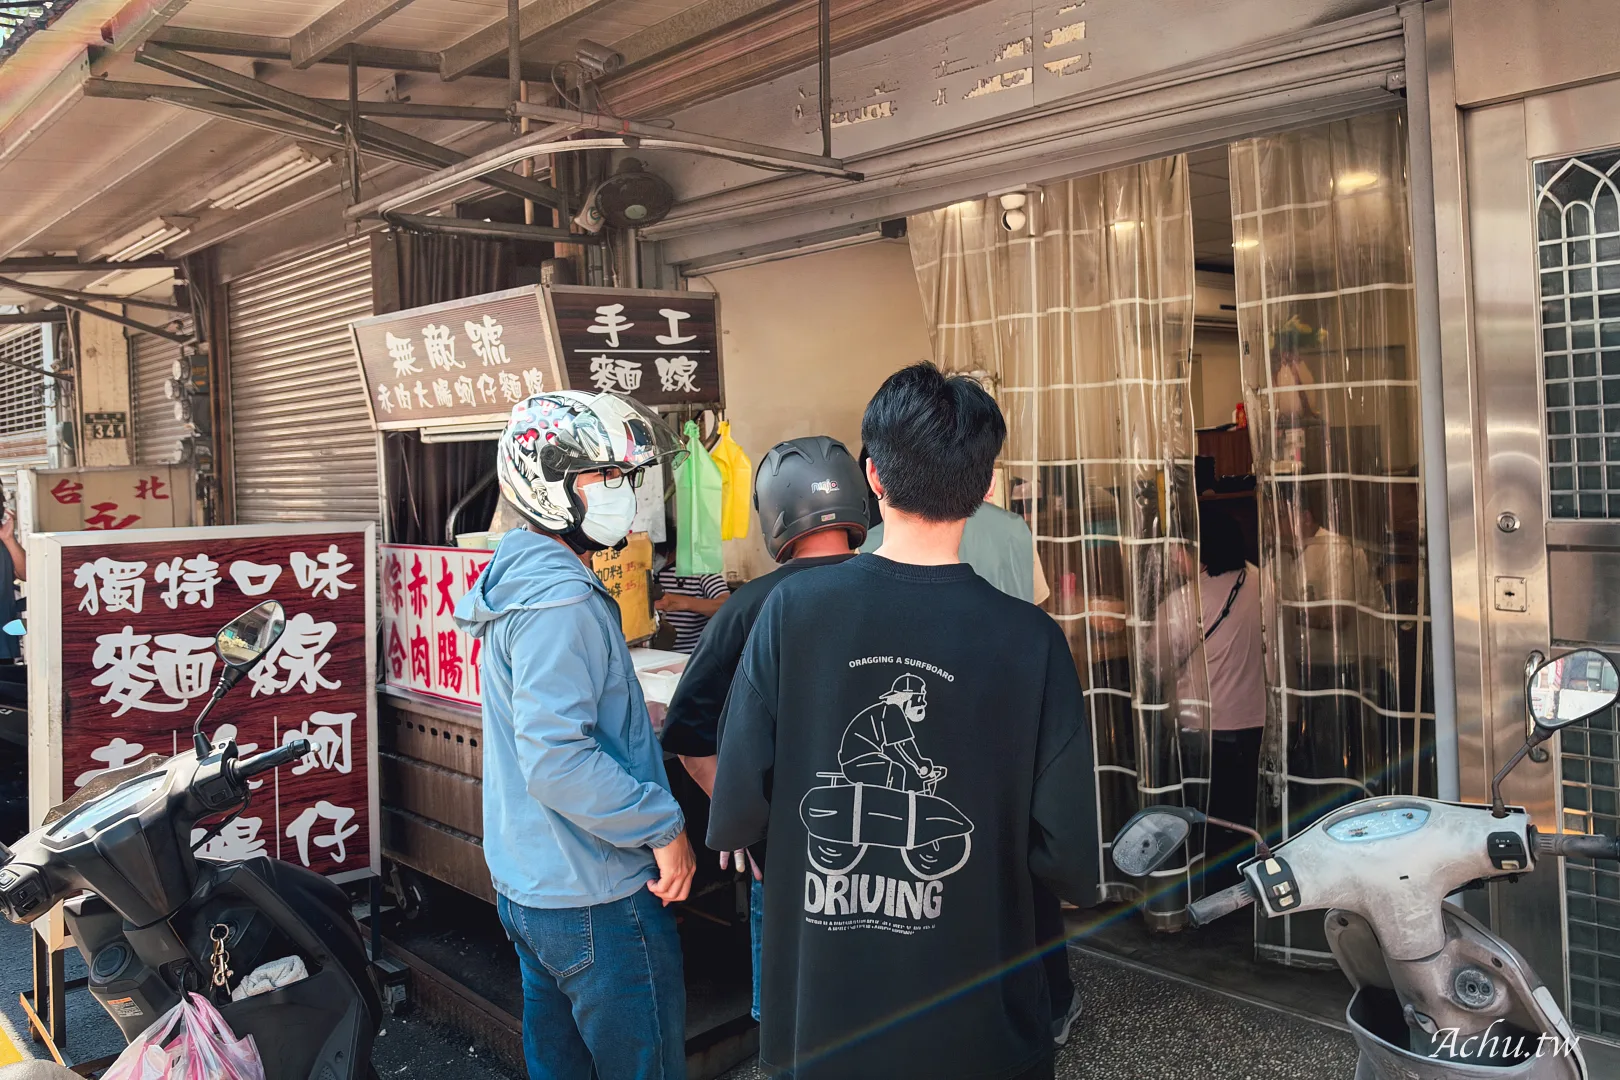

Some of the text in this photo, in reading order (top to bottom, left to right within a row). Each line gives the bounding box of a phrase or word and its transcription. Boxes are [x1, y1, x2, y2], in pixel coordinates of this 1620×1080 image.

[587, 303, 697, 348] 手工
[589, 354, 701, 396] 麵線
[94, 424, 125, 438] 341
[50, 475, 169, 505] 台北
[74, 544, 357, 616] 獨特口味
[407, 552, 431, 689] 赤肉
[436, 556, 463, 694] 大腸
[91, 612, 342, 718] 麵線
[896, 656, 902, 664] A
[282, 711, 360, 867] 蚵仔
[804, 871, 944, 920] DRIVING
